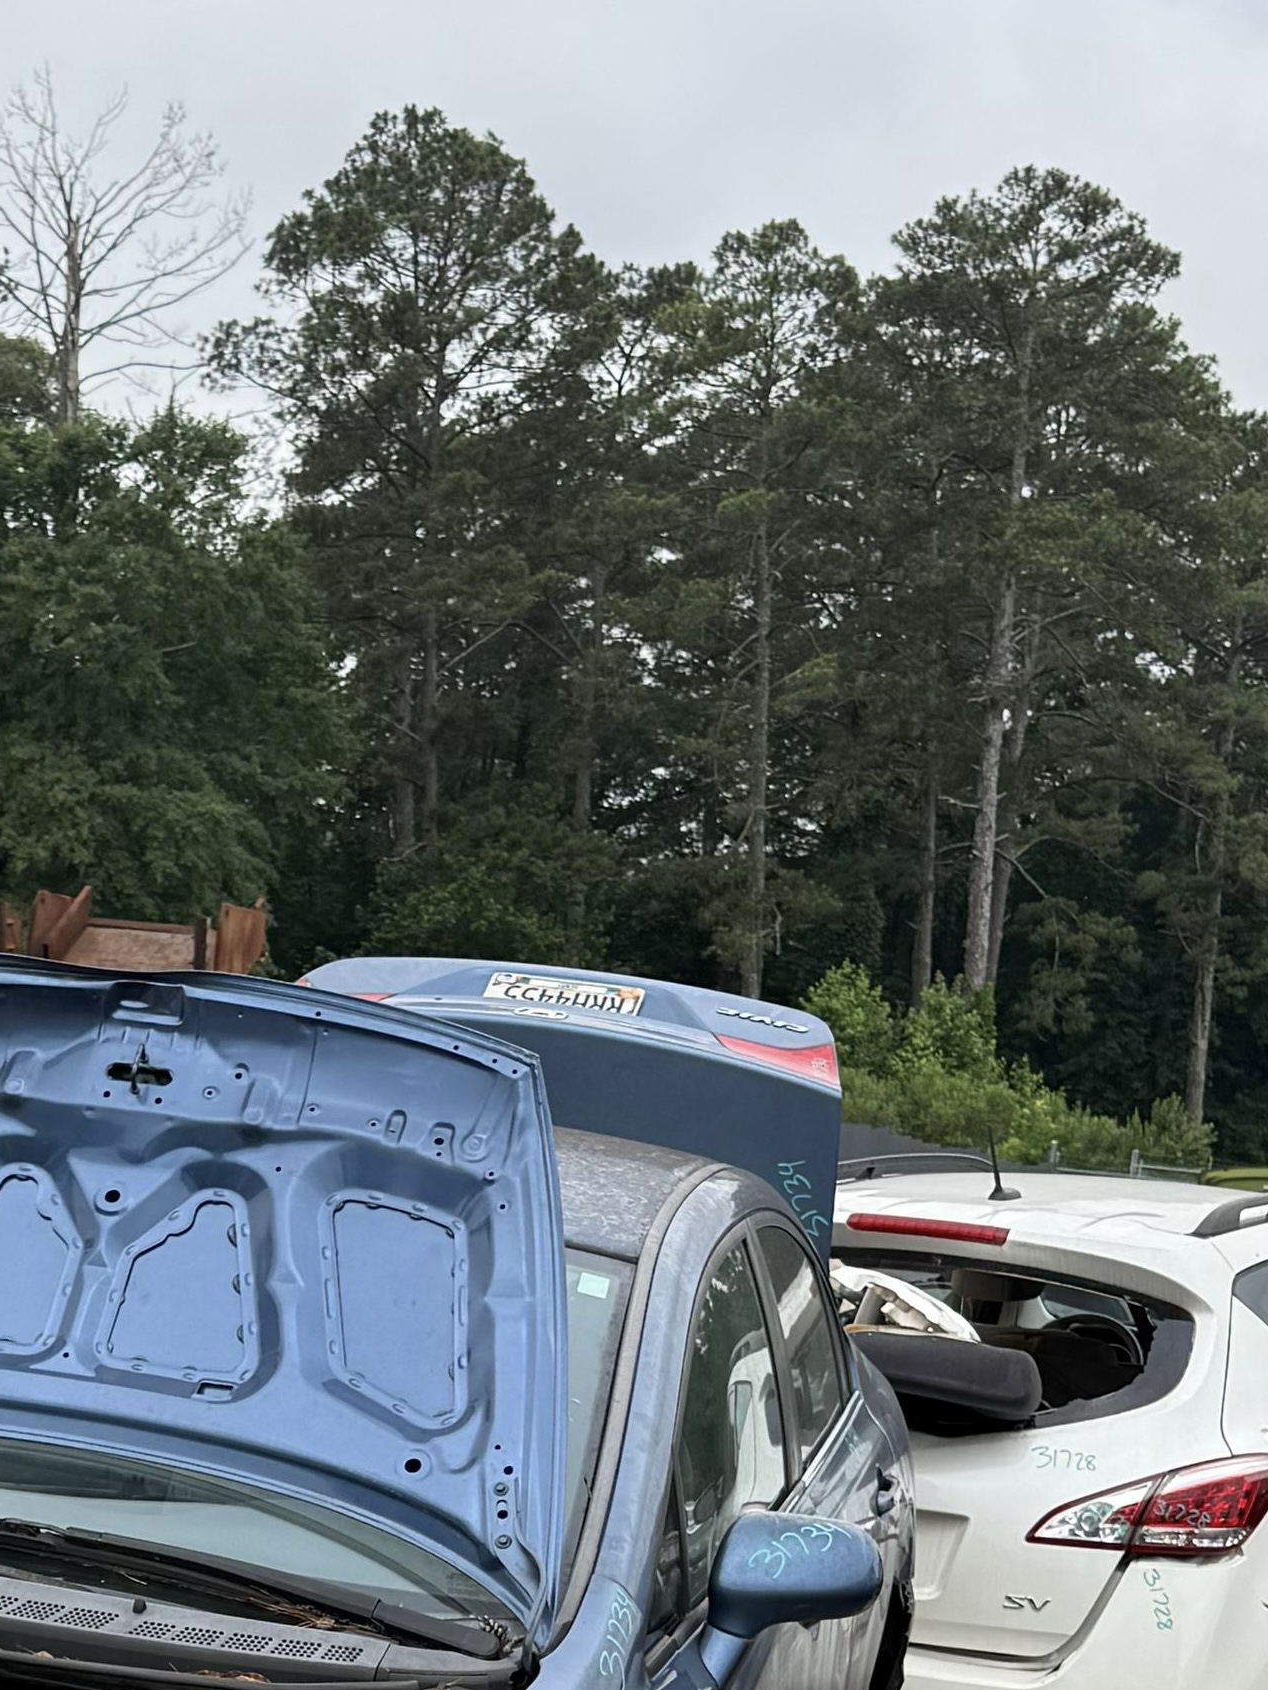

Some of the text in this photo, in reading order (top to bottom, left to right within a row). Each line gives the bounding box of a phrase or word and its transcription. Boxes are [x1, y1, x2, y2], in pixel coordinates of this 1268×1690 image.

[715, 1006, 809, 1034] CIVIC
[777, 1160, 829, 1237] 31734
[1030, 1445, 1099, 1472] 31728
[1153, 1499, 1211, 1530] 31728
[748, 1520, 852, 1579] 31734
[1002, 1594, 1051, 1613] SV
[1143, 1568, 1173, 1631] 31728
